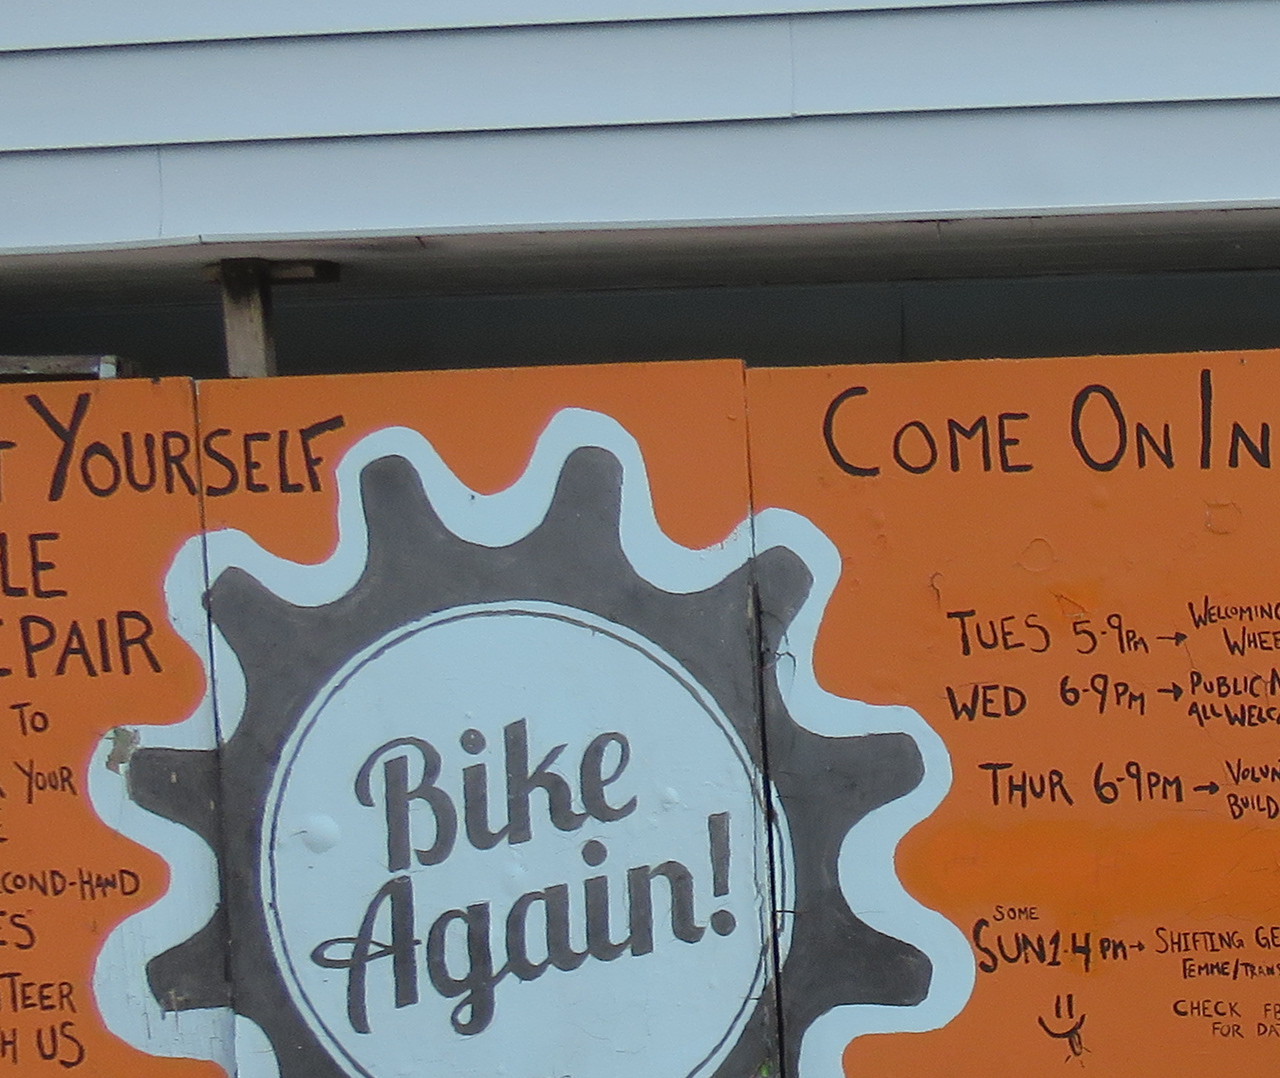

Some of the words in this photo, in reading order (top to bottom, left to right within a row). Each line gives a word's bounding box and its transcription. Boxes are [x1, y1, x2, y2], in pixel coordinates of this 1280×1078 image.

[25, 392, 345, 502] YOURSELF
[823, 385, 1034, 477] COME
[1071, 384, 1174, 472] ON
[947, 610, 1051, 656] TUES
[10, 702, 49, 736] TO
[946, 684, 1027, 722] WED
[1190, 671, 1262, 698] PUBLIC
[1188, 704, 1222, 728] ALL
[13, 759, 78, 804] YOUR
[354, 717, 637, 873] Bike
[978, 763, 1074, 808] THUR
[1094, 761, 1183, 804] 6-9PM
[1226, 793, 1280, 820] BUILD
[0, 867, 140, 900] COND-HAND
[310, 811, 737, 1035] Again!
[992, 905, 1040, 922] SOME
[1155, 926, 1246, 954] SHIFTING
[1172, 999, 1242, 1018] CHECK
[1212, 1022, 1245, 1038] FOR
[37, 1021, 86, 1068] US
